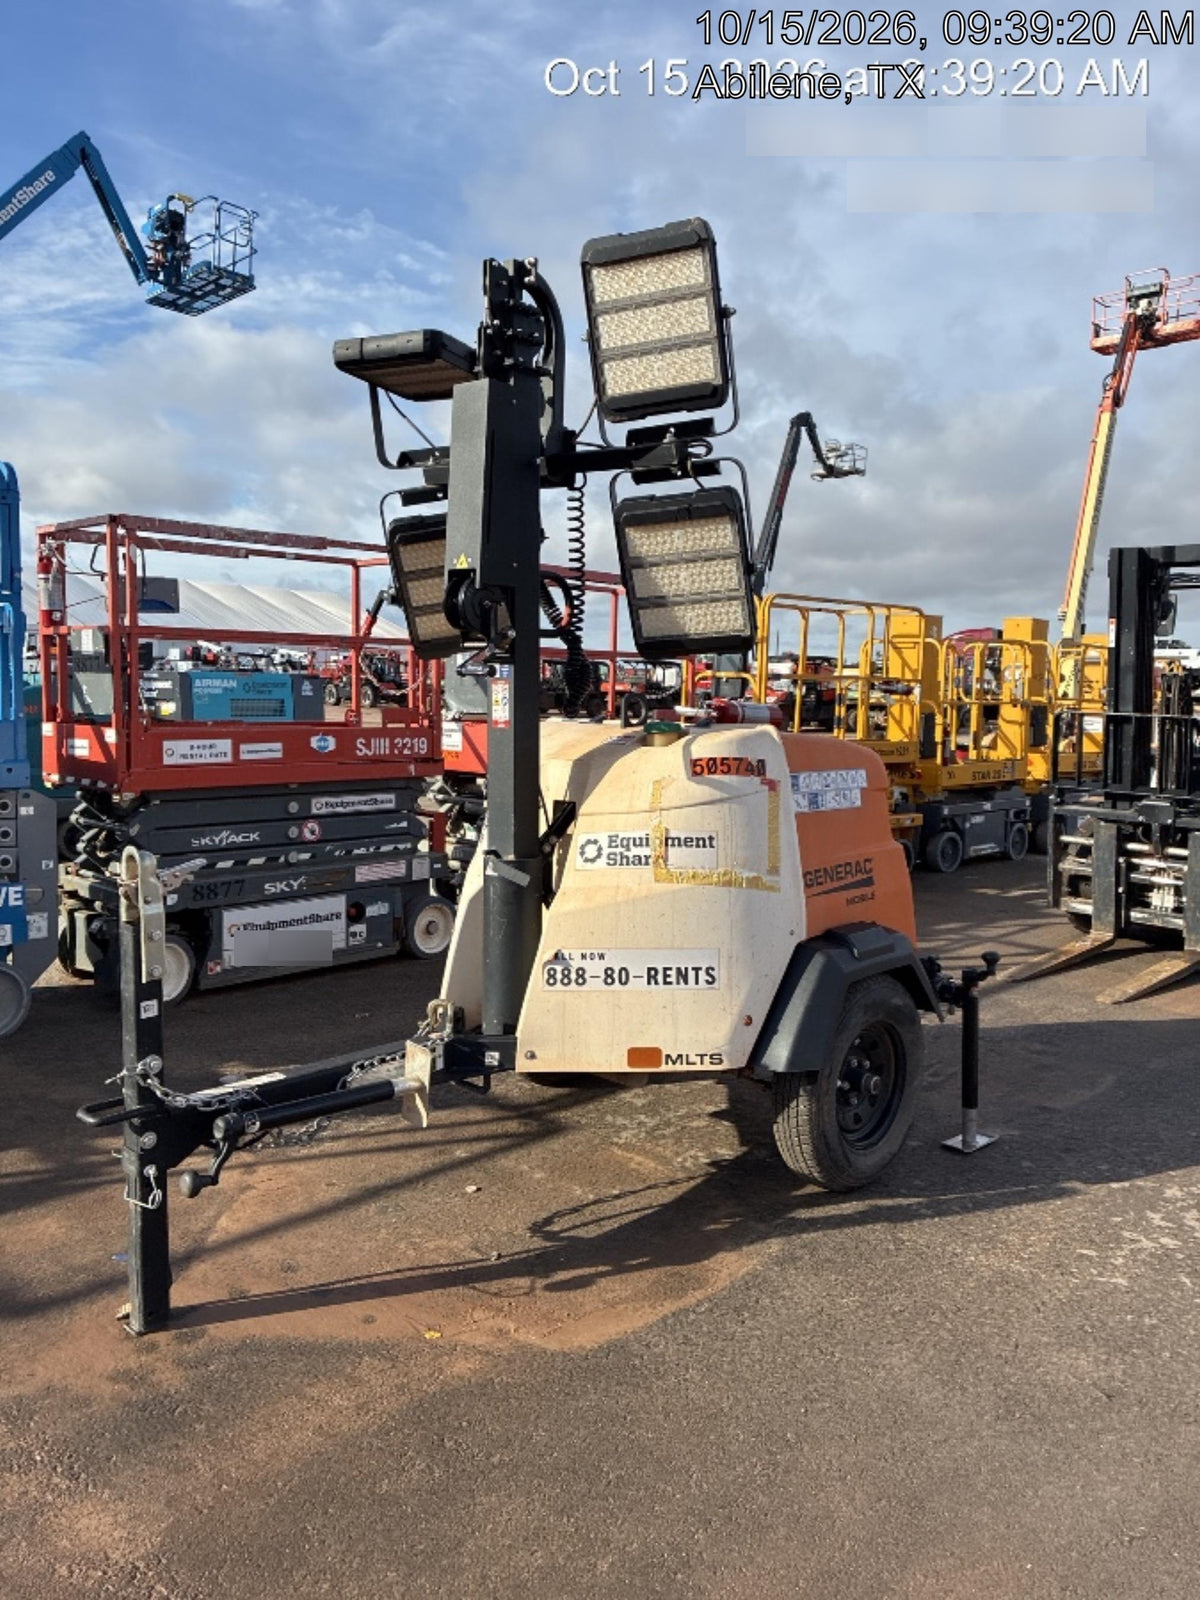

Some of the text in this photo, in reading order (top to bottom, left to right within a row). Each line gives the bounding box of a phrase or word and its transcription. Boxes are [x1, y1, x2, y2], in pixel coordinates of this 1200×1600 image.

[194, 678, 237, 688] AIRMAN
[191, 829, 260, 847] SKYJACK
[606, 833, 716, 854] Equiment
[605, 852, 662, 867] Shar
[802, 857, 874, 889] GENERAC
[845, 890, 875, 906] MOBILE
[580, 952, 607, 961] NOW
[545, 966, 717, 987] 888-80-RENTS
[664, 1053, 725, 1066] MLTS
